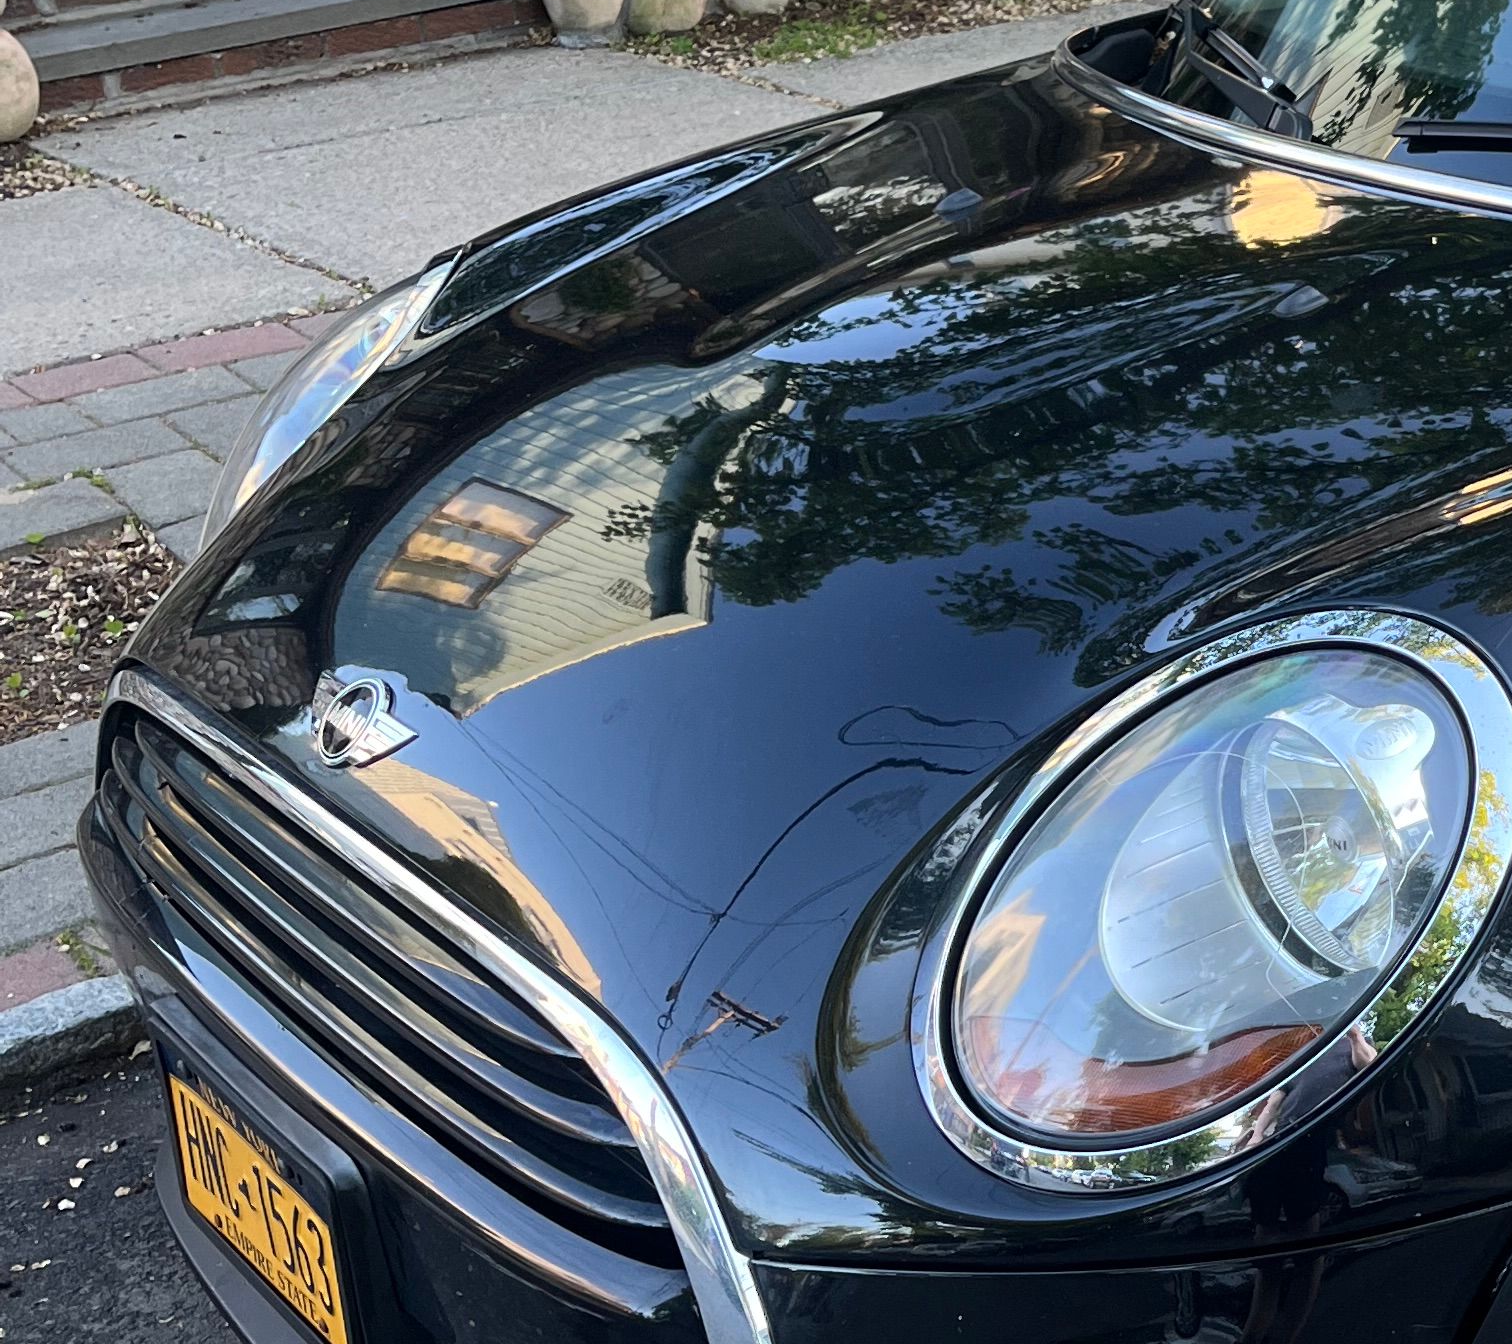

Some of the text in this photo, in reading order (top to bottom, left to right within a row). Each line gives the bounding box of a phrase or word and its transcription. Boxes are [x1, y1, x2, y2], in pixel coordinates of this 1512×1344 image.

[224, 1213, 318, 1324] EMPIRE STATE
[252, 1163, 335, 1317] 1563
